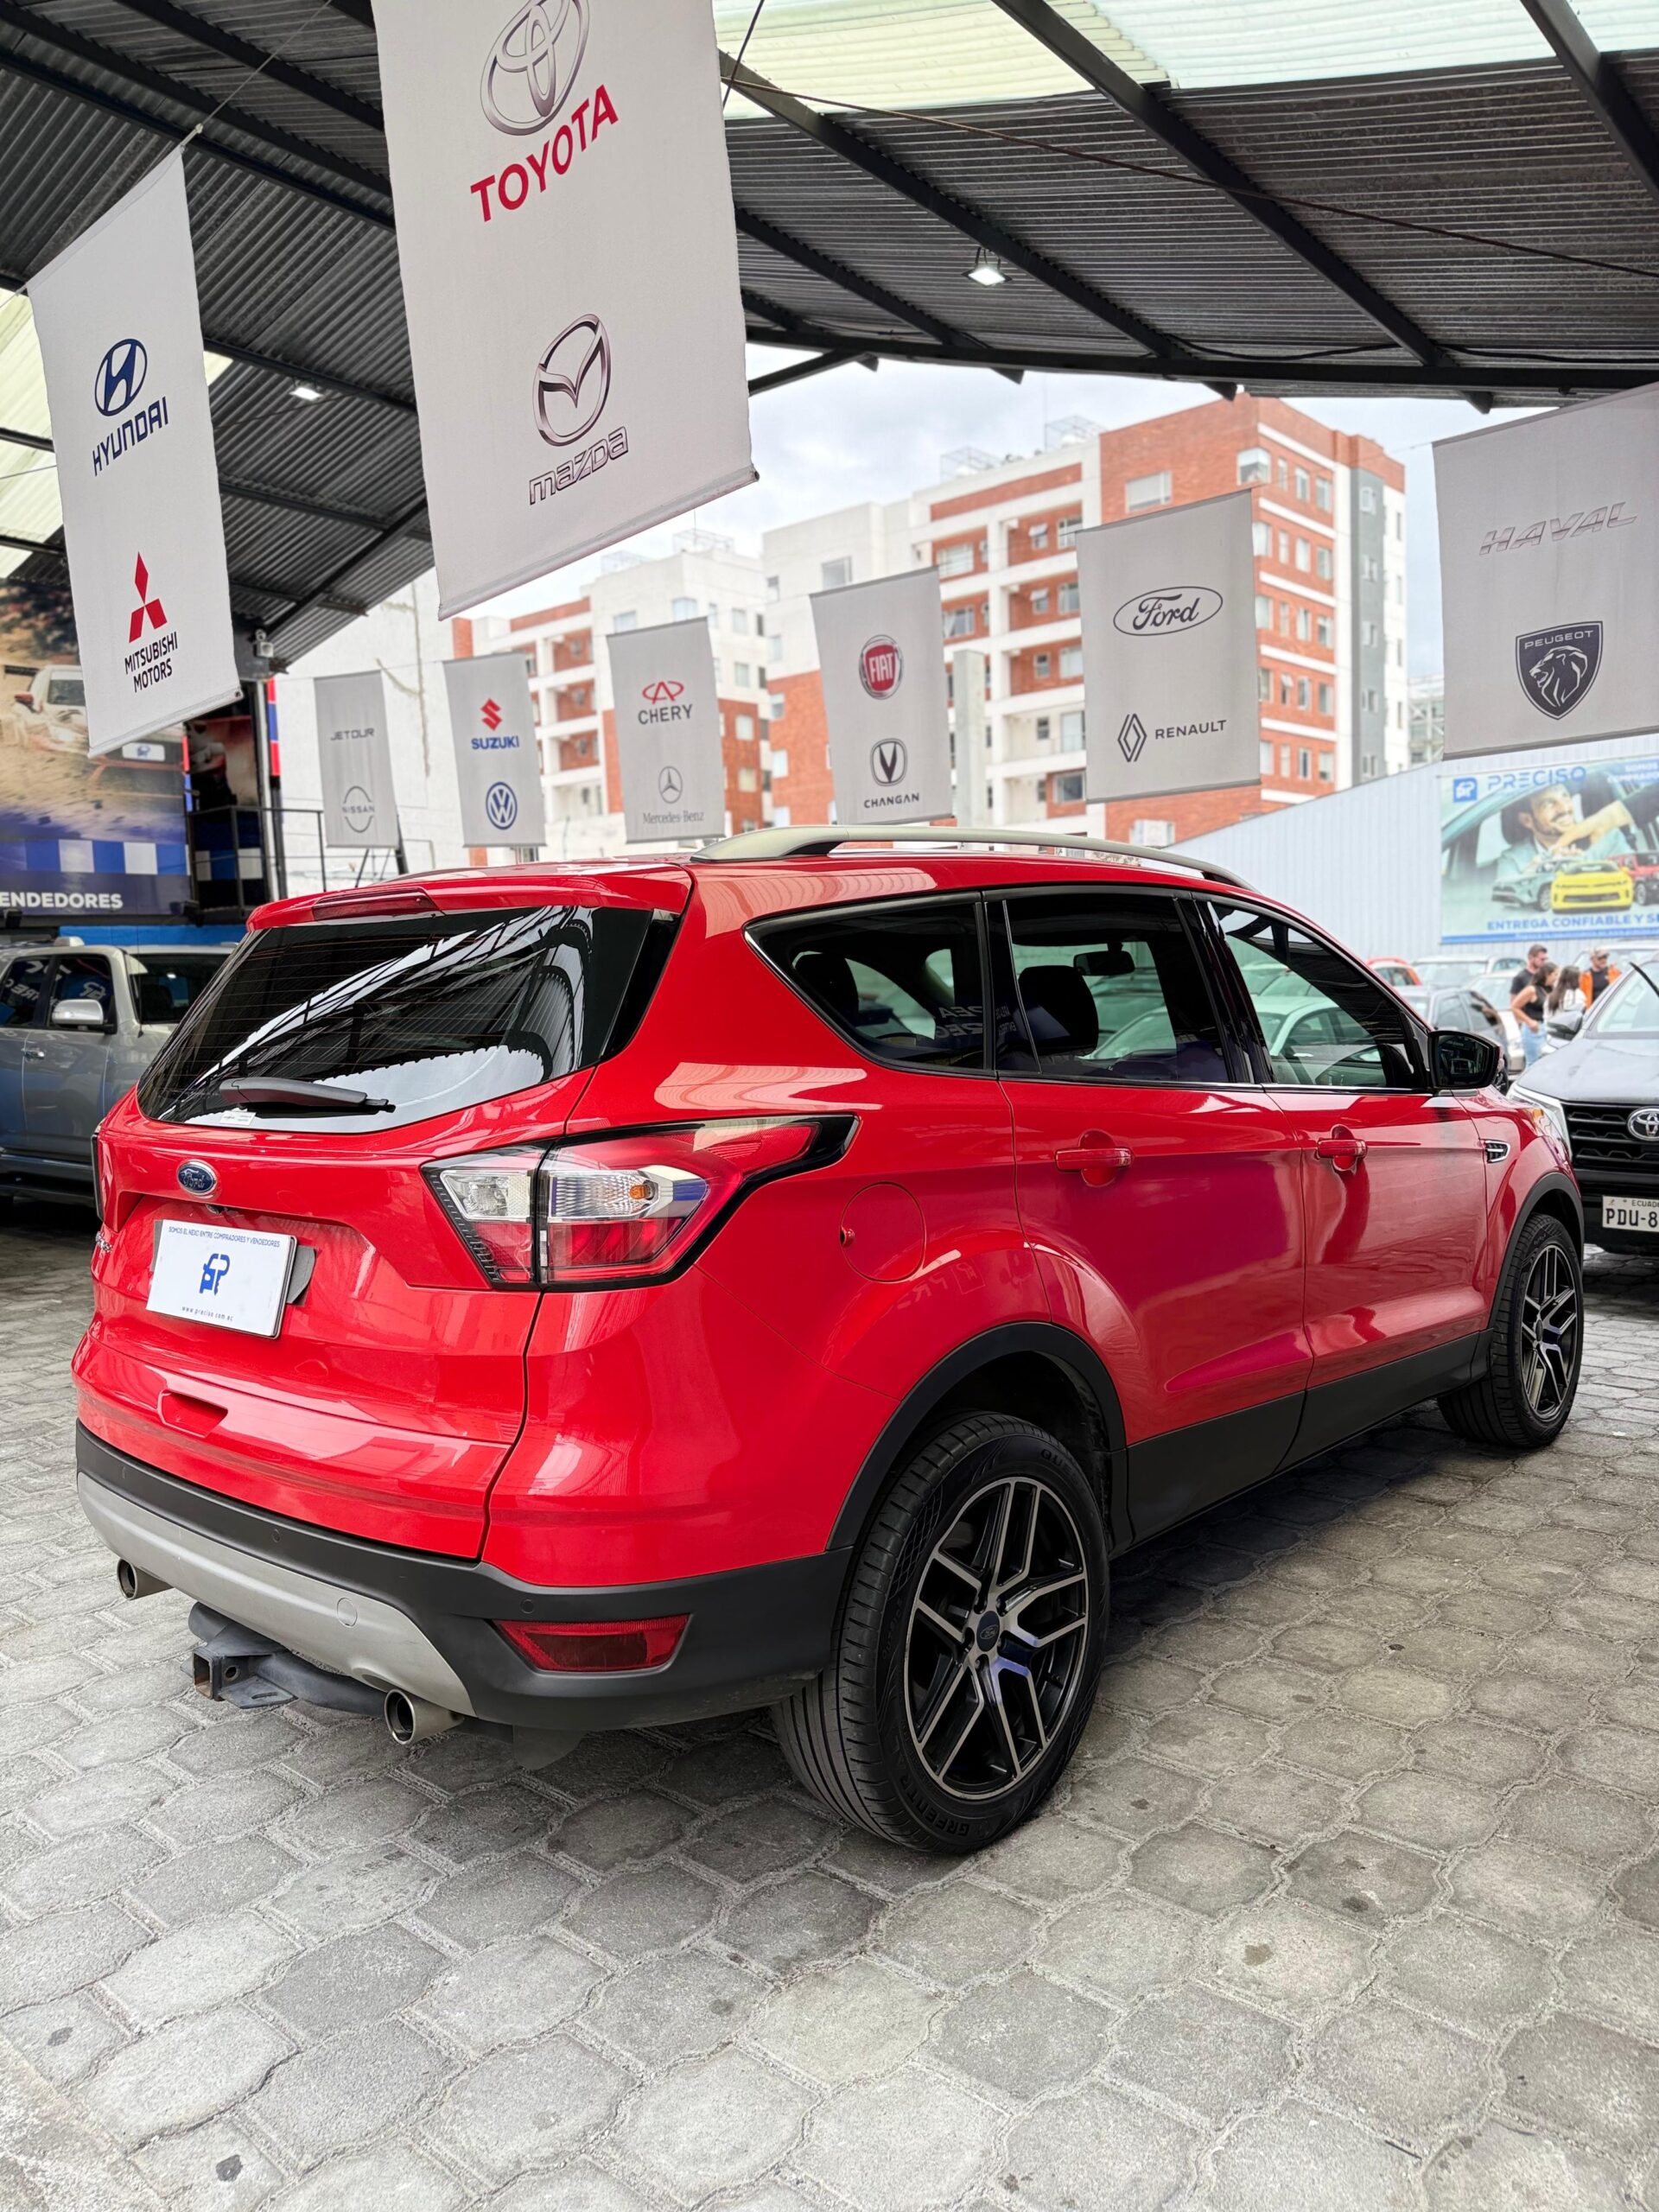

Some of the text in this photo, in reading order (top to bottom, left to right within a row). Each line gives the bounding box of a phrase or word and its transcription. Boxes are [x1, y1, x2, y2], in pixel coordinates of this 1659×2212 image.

[470, 84, 619, 222] TOYOTA
[92, 396, 168, 477] HYUNDAI
[1479, 501, 1637, 556] HAVAL
[1133, 594, 1200, 630] Ford
[1524, 630, 1593, 650] PEUGEOT
[124, 631, 178, 675] MITSUBISHI
[133, 658, 173, 693] MOTORS
[868, 652, 894, 683] FIAT
[638, 703, 693, 725] CHERY
[330, 728, 375, 741] JETOUR
[1154, 720, 1227, 740] RENAULT
[471, 735, 520, 750] SUZUKI
[1488, 766, 1586, 790] PRECISO
[342, 805, 375, 814] NISSAN
[864, 792, 920, 809] CHANGAN
[643, 810, 704, 824] Mercedes-Benz
[1487, 918, 1548, 931] ENTREGA
[1552, 913, 1631, 928] CONFIABLE
[1633, 913, 1644, 924] Y
[180, 1168, 206, 1189] Ford
[1631, 1199, 1659, 1208] ECUAD
[1605, 1208, 1658, 1228] PDU-8
[213, 1232, 246, 1243] COMPRADORES
[251, 1236, 280, 1247] VENDEDORES
